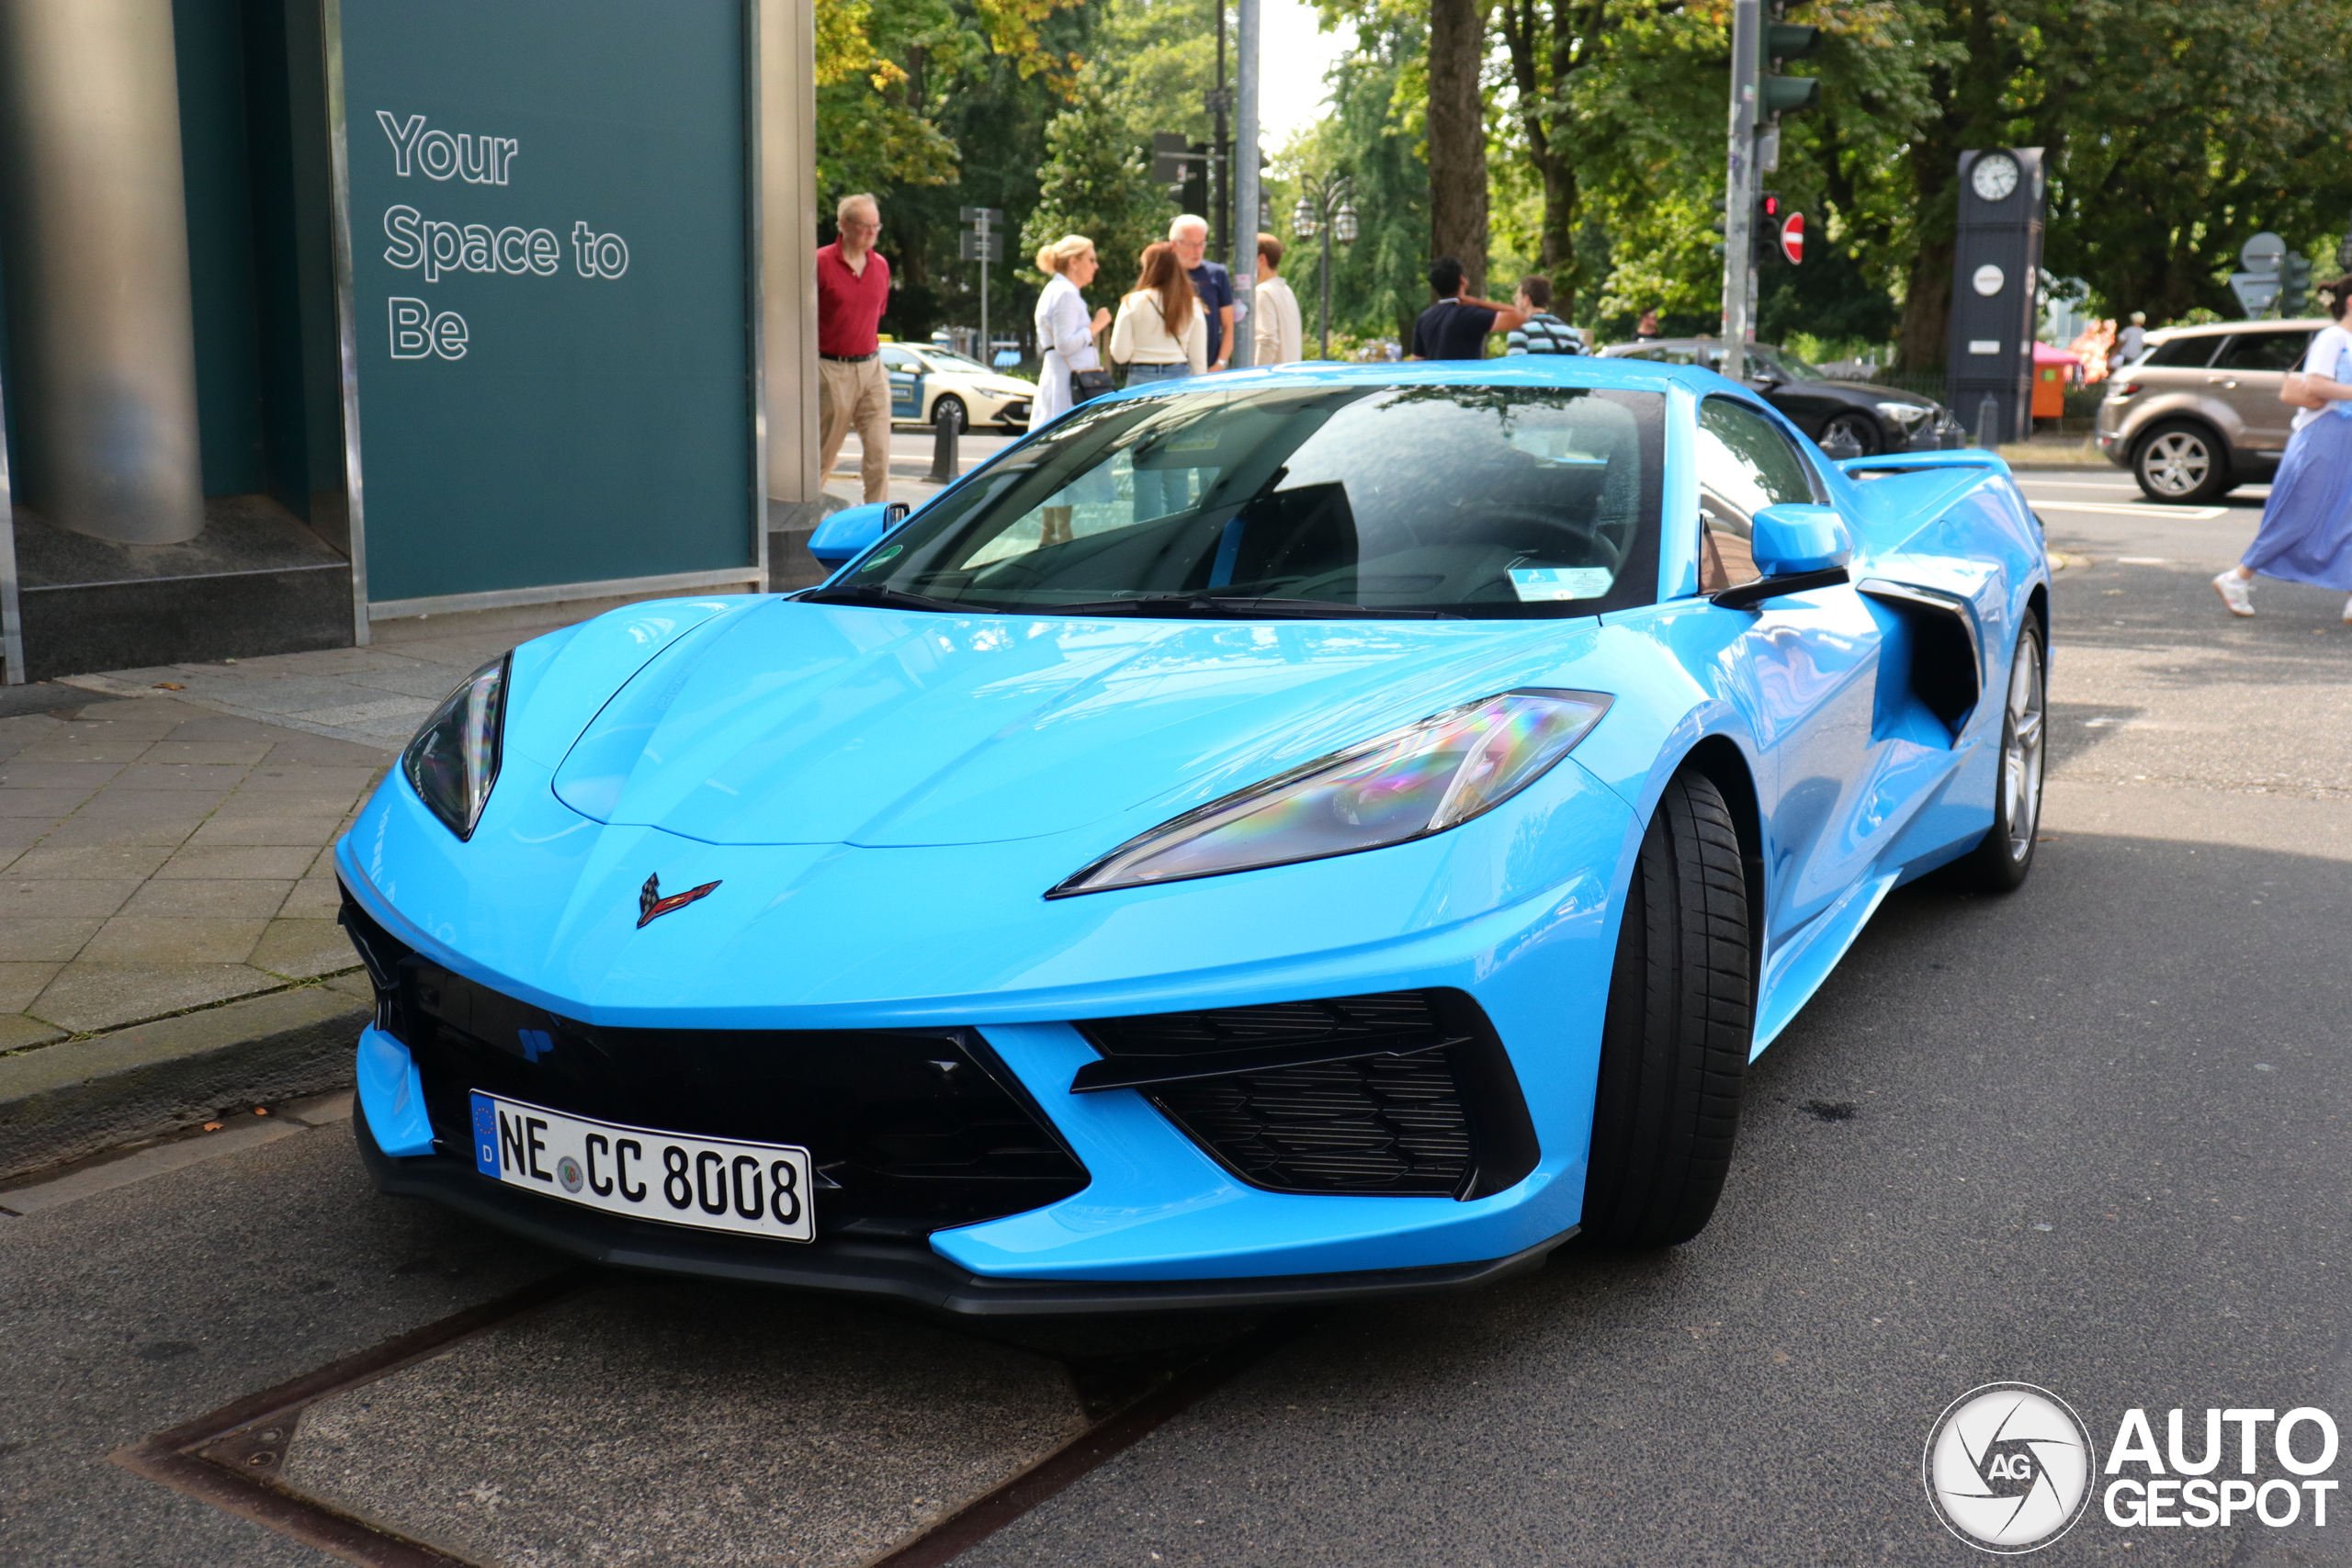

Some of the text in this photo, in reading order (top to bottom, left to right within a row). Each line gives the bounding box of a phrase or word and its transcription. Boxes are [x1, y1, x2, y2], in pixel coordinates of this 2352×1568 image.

[376, 110, 518, 186] Your
[383, 204, 629, 283] Space to
[388, 297, 469, 361] Be
[482, 1145, 492, 1163] D
[499, 1110, 554, 1182] NE
[585, 1133, 647, 1202] CC
[662, 1145, 801, 1225] 8008
